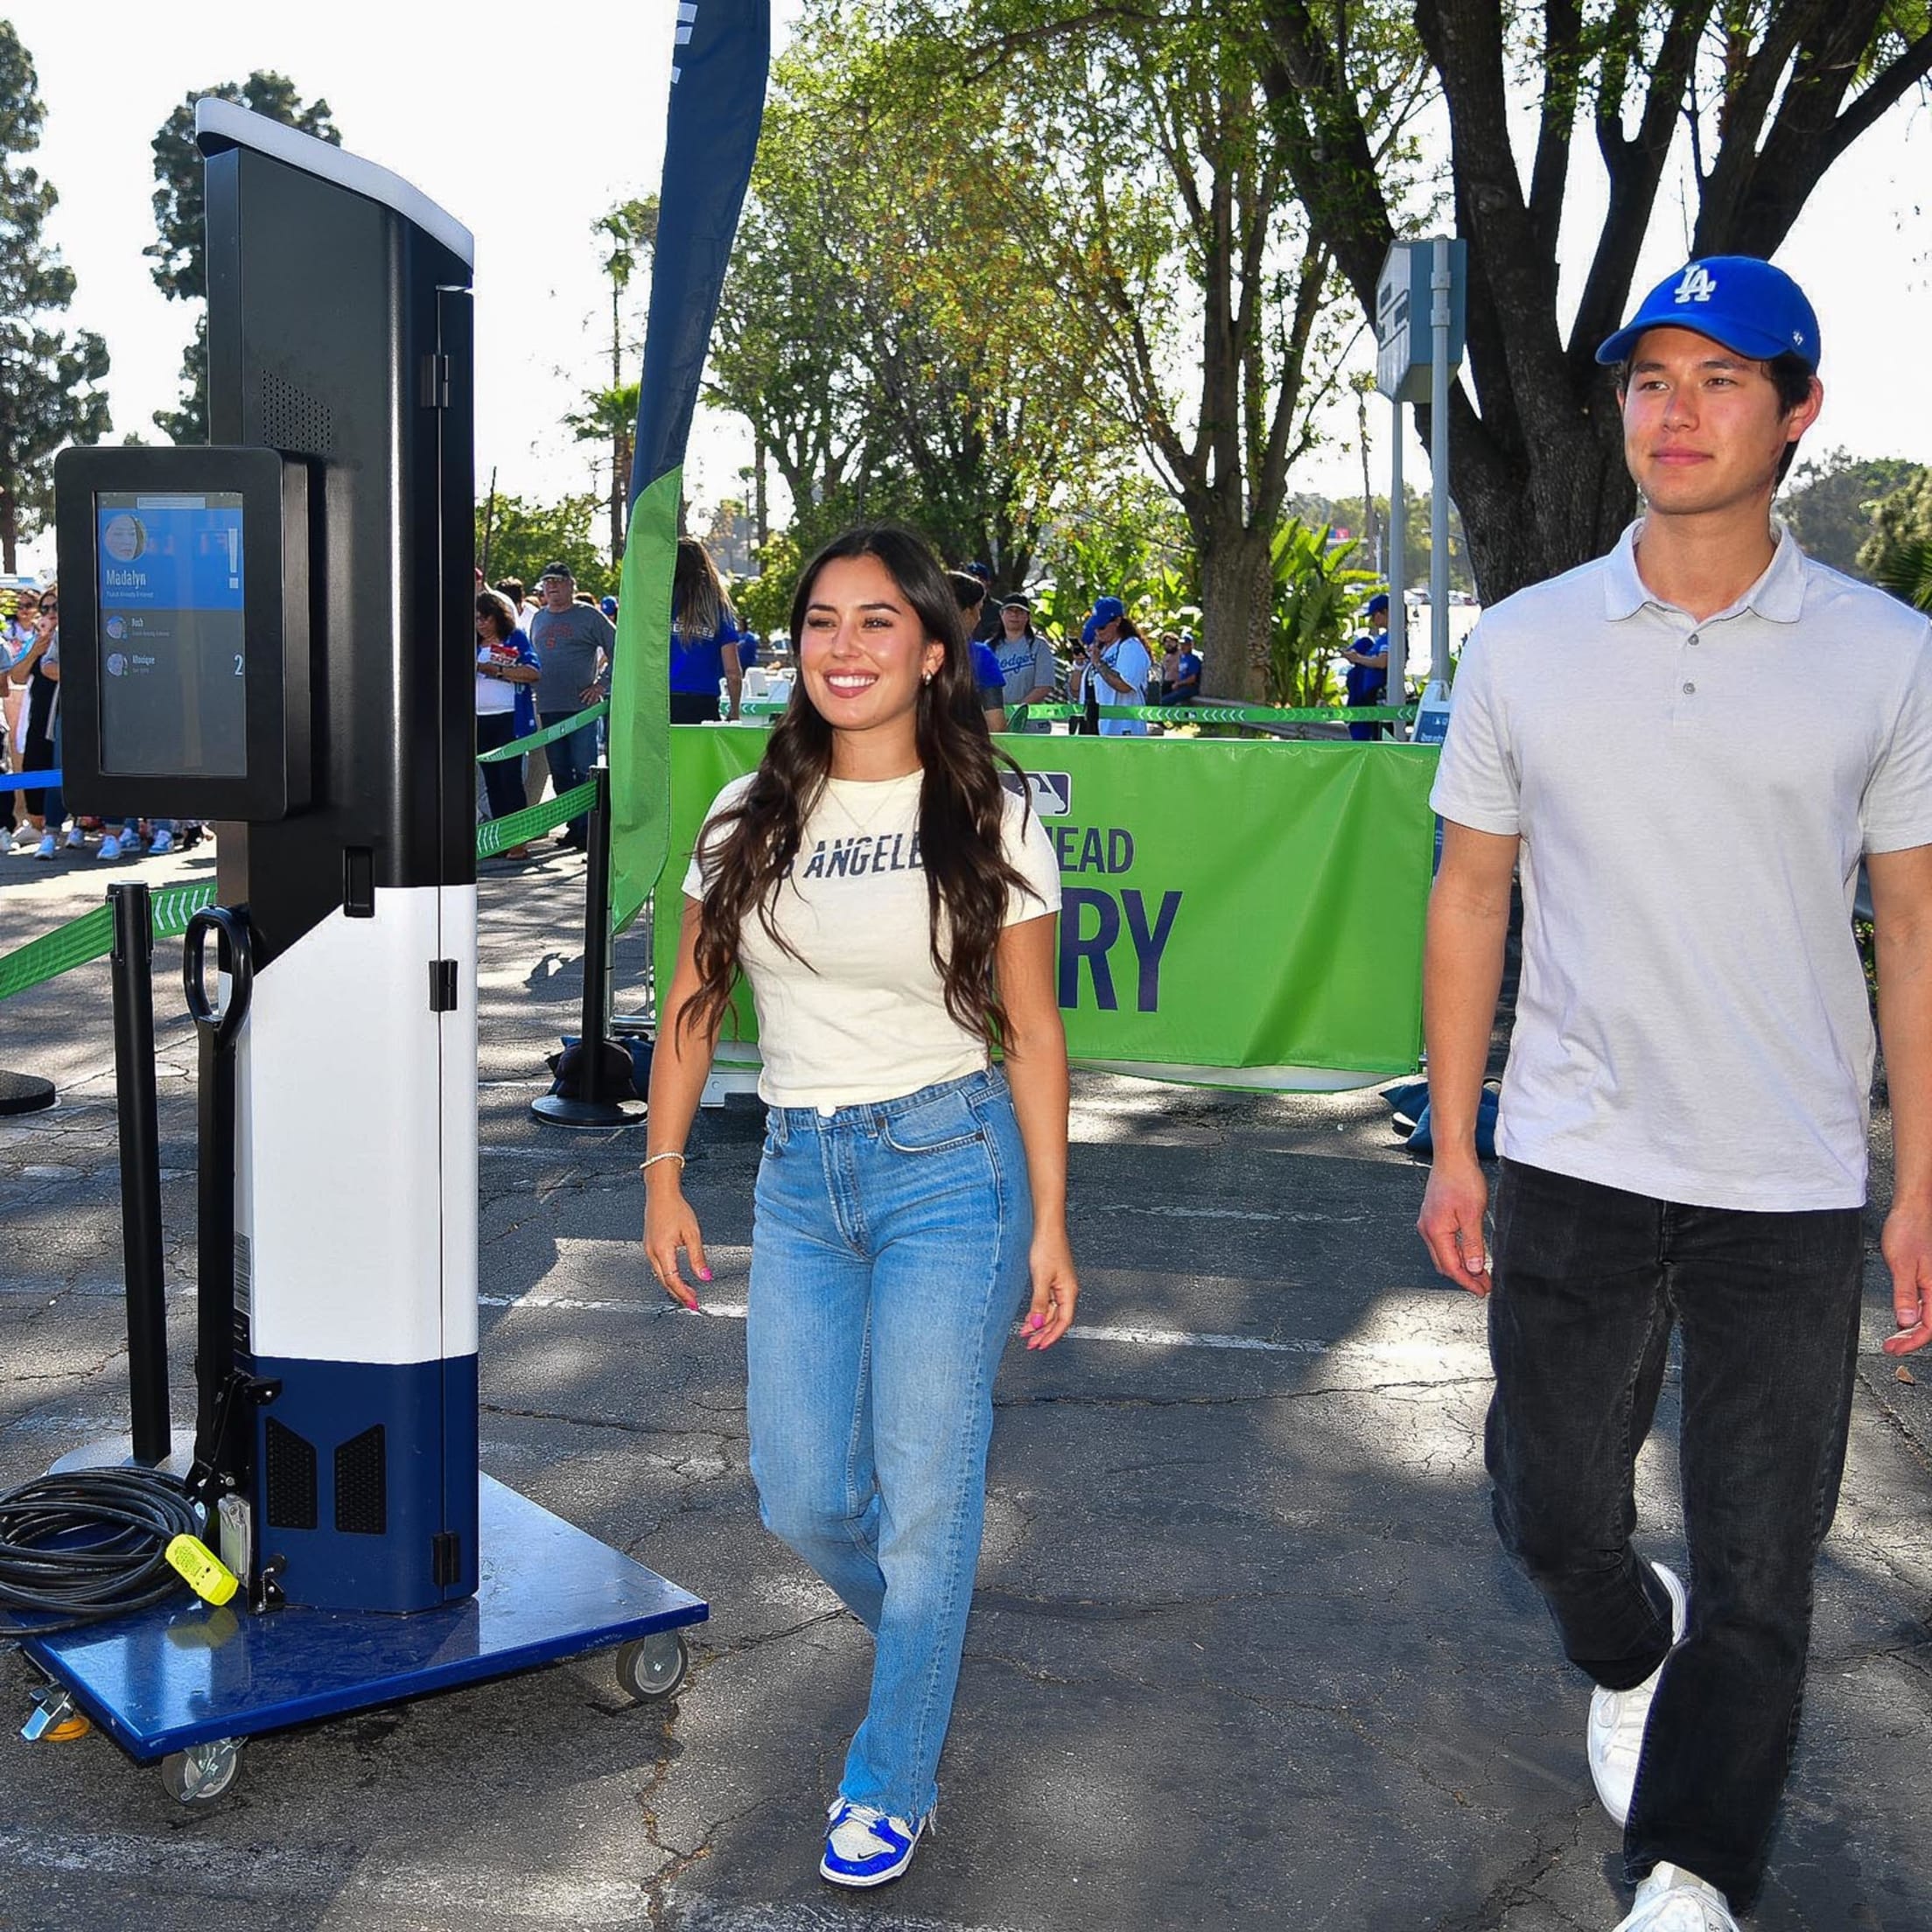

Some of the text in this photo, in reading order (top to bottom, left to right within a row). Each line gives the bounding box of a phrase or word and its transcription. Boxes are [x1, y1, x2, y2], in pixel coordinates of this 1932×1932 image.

[1675, 264, 1717, 304] LA
[106, 569, 146, 590] Madalyn
[234, 654, 244, 676] 2
